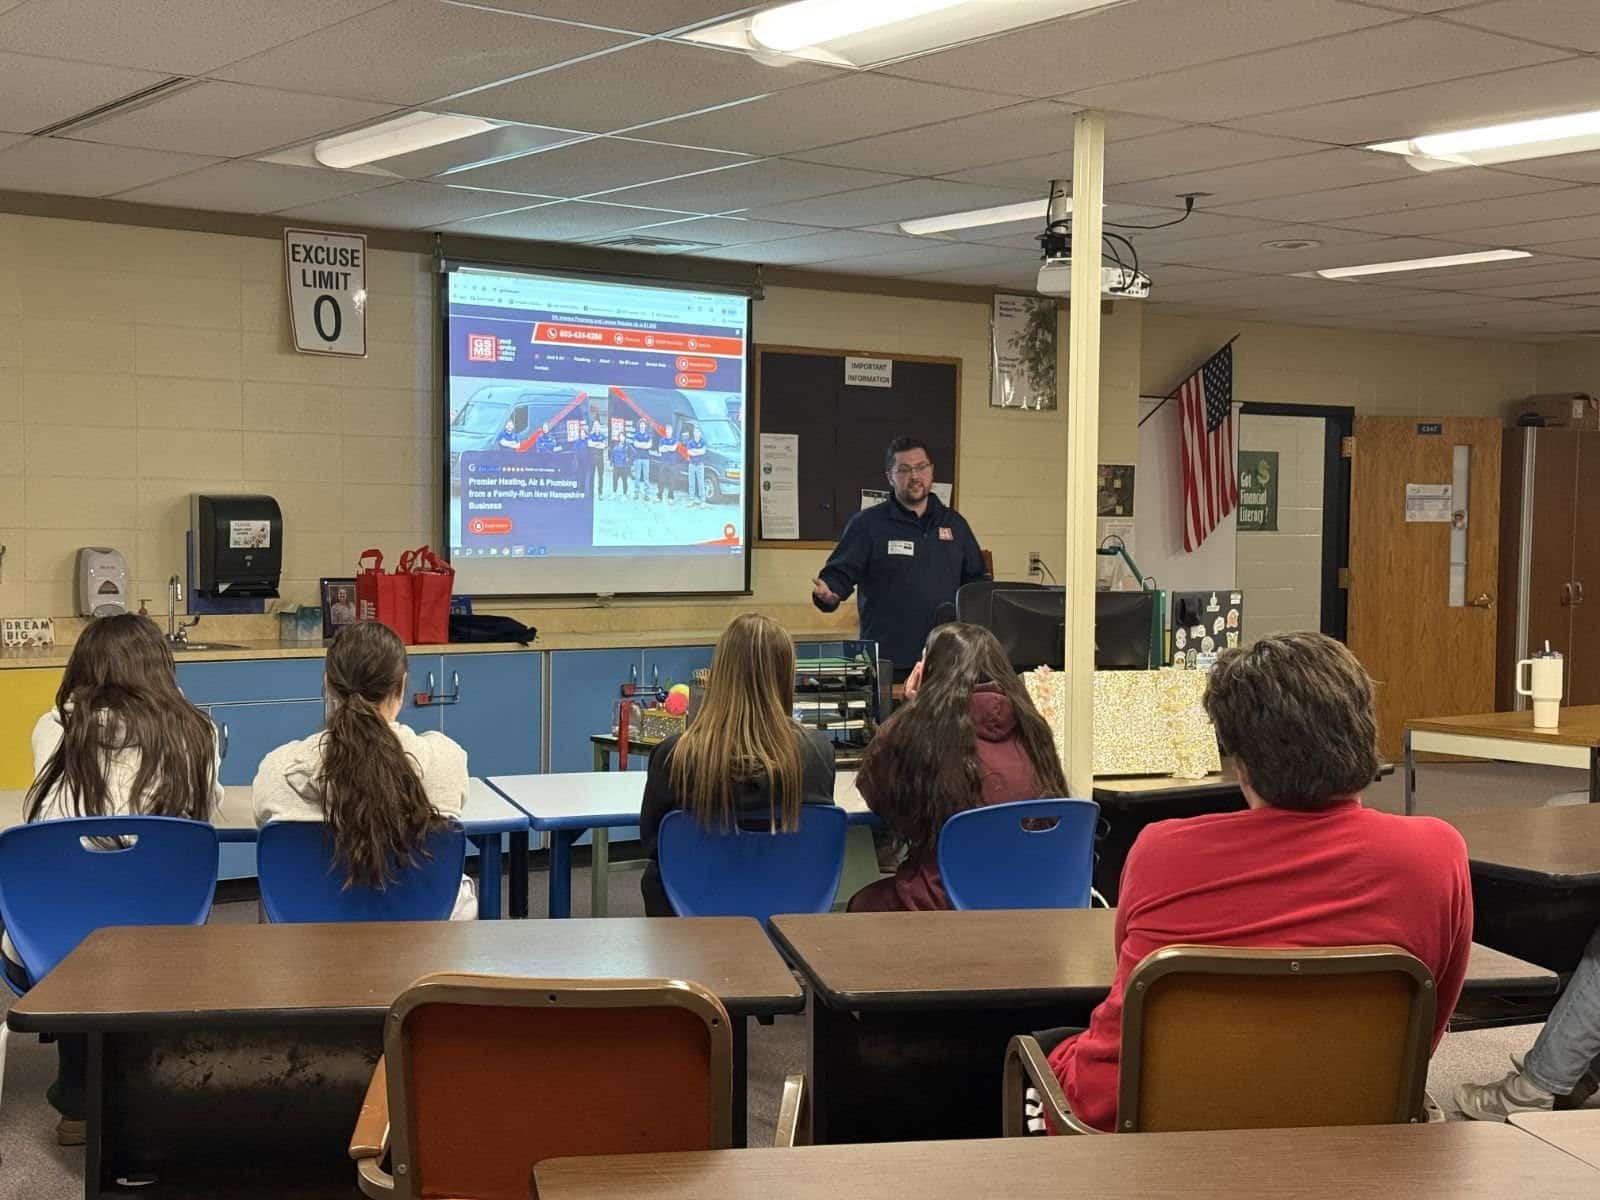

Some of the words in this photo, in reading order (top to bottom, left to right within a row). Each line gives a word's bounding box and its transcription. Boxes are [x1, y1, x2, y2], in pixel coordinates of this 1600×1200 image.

[291, 244, 360, 268] EXCUSE
[302, 268, 351, 290] LIMIT
[314, 294, 341, 342] 0
[851, 361, 887, 370] IMPORTANT
[847, 374, 890, 384] INFORMATION
[468, 477, 498, 486] Premier
[498, 478, 527, 488] Heating,
[528, 478, 539, 487] Air
[546, 479, 578, 488] Plumbing
[1240, 472, 1252, 488] Got
[468, 490, 486, 498] from
[493, 490, 533, 499] Family-Run
[534, 490, 548, 498] New
[549, 490, 585, 500] Hampshire
[1240, 488, 1267, 505] Financial
[468, 502, 503, 510] Business
[1240, 506, 1265, 527] Literacy
[6, 620, 50, 630] DREAM
[7, 631, 28, 640] BIG
